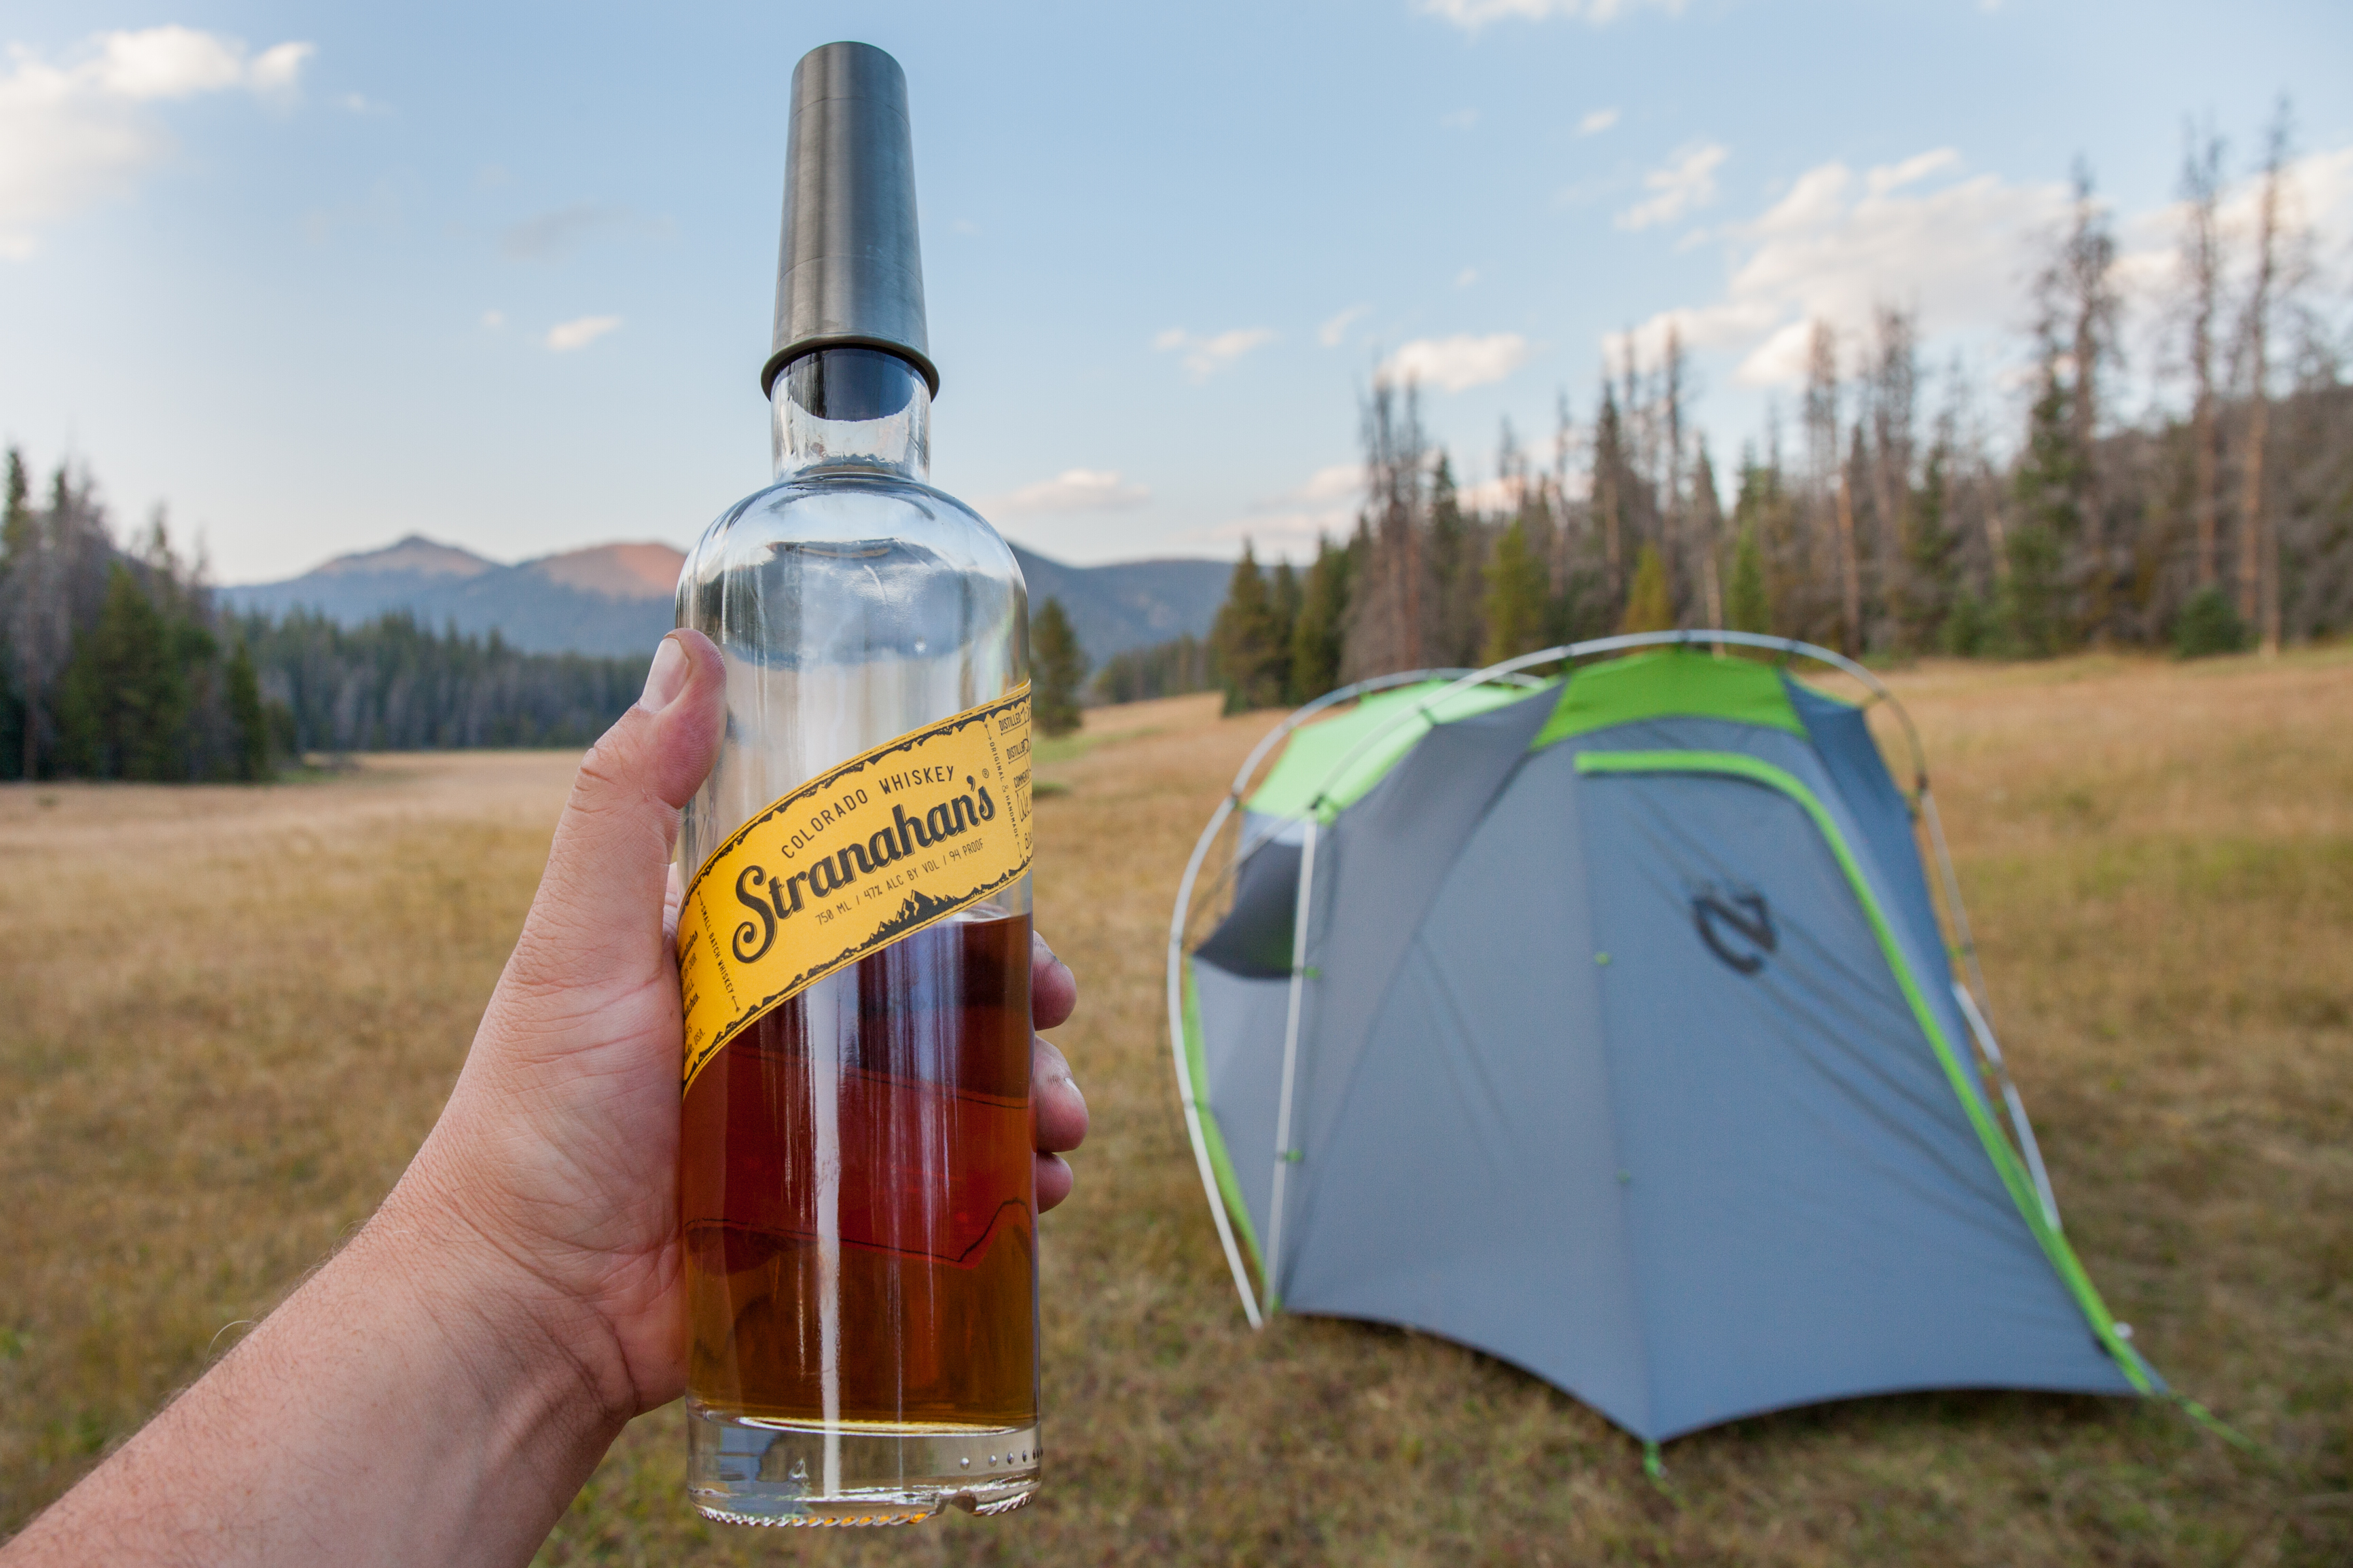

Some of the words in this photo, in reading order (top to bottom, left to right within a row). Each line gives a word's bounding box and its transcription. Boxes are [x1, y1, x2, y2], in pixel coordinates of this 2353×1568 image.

[990, 742, 1005, 782] ORIGINAL
[1002, 784, 1009, 793] &
[781, 788, 869, 859] COLORADO
[878, 765, 954, 795] WHISKEY
[1005, 795, 1019, 839] HANDMADE
[732, 775, 996, 965] Stranahan's
[815, 909, 834, 926] 750
[836, 900, 852, 914] ML
[863, 884, 883, 900] 47%
[886, 874, 904, 891] ALC
[907, 867, 919, 881] BY
[922, 858, 940, 873] VOL
[949, 848, 962, 862] 94
[962, 838, 984, 857] PROOF
[700, 905, 711, 932] SMALL
[708, 932, 721, 959] BATCH
[717, 959, 734, 993] WHISKEY
